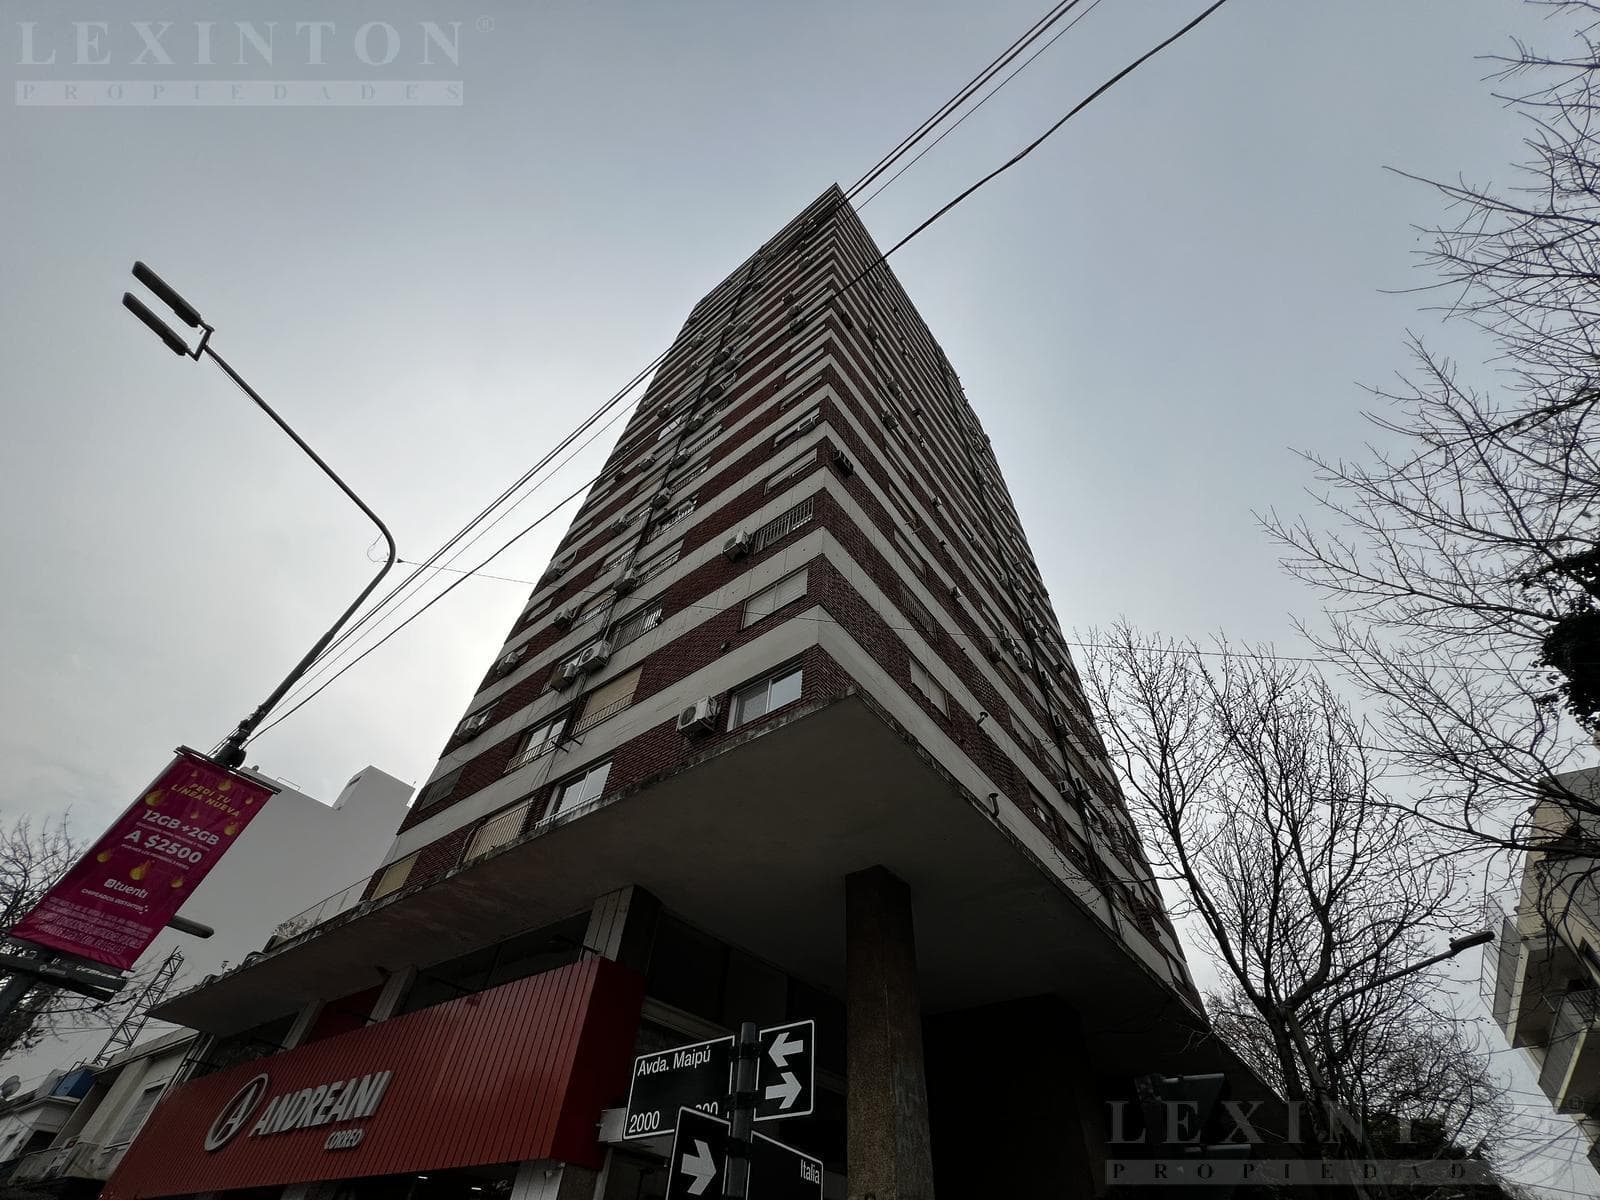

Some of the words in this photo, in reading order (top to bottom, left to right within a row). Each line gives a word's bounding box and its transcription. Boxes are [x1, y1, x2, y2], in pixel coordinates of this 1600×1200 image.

[205, 795, 240, 817] NUEVA
[216, 793, 231, 804] TU
[143, 810, 181, 829] 12GB
[124, 830, 141, 843] A
[143, 833, 202, 864] $2500
[637, 1060, 670, 1077] Avda.
[673, 1045, 711, 1069] Maipú
[248, 1070, 393, 1137] ANDREANI
[628, 1110, 660, 1134] 2000
[324, 1129, 363, 1150] CORREO
[800, 1159, 820, 1184] Italia
